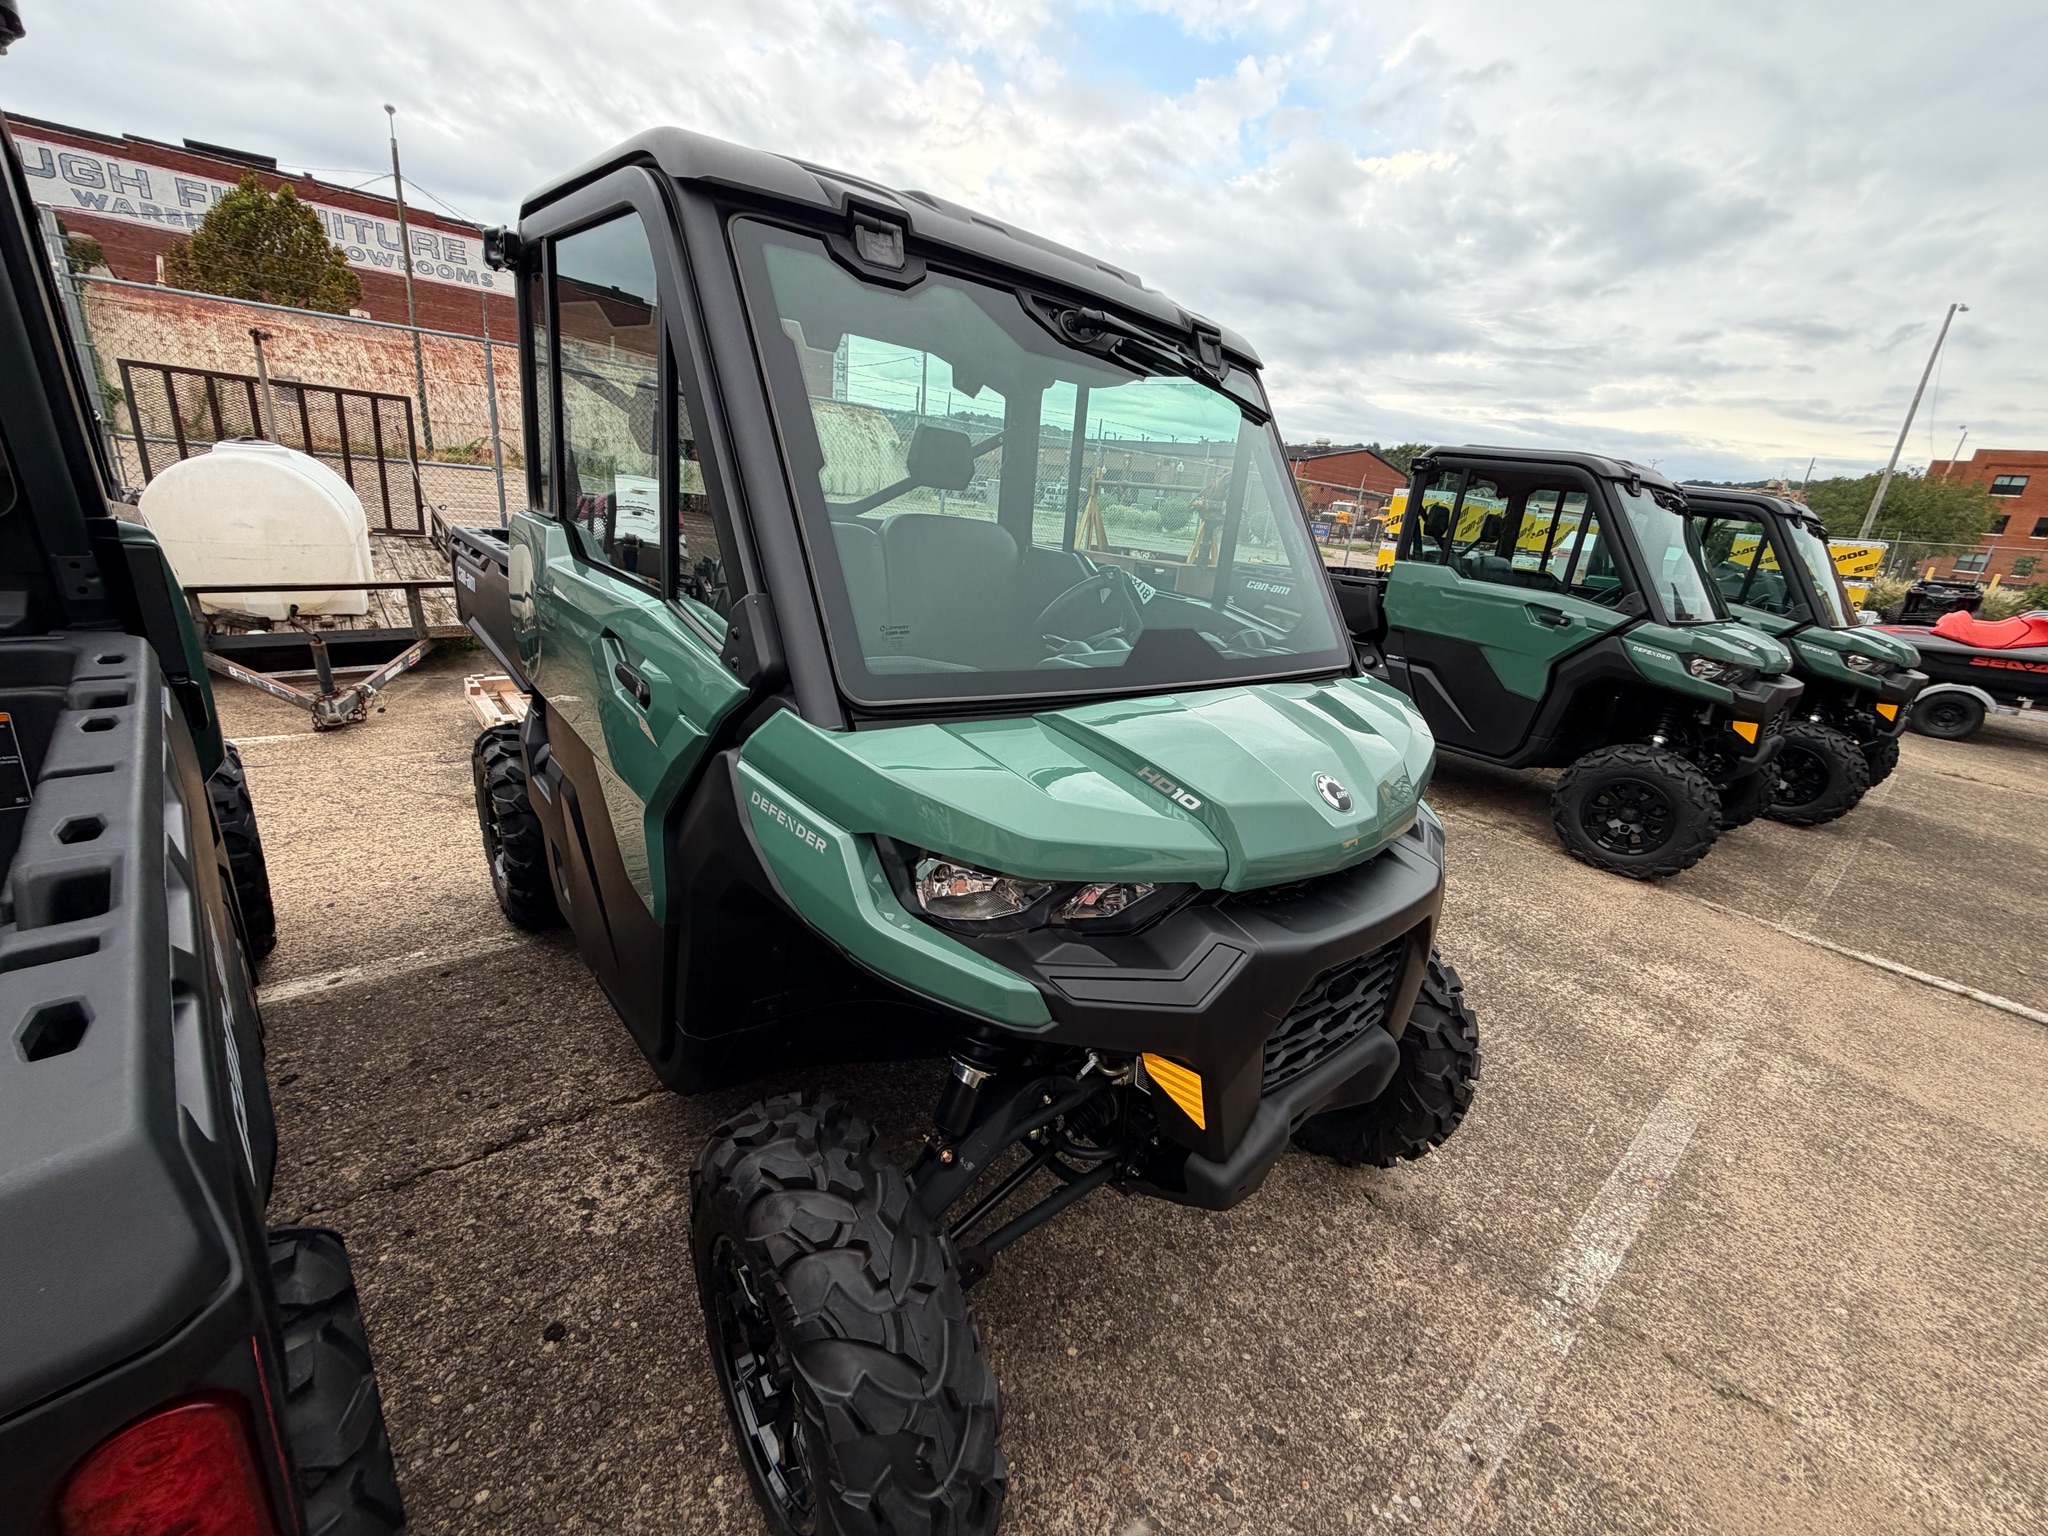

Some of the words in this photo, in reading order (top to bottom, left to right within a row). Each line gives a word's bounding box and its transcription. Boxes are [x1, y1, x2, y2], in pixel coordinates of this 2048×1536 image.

[1246, 579, 1291, 596] can-am
[1632, 645, 1672, 661] DEFENDER
[1800, 644, 1834, 657] DEFENDER
[1137, 766, 1203, 811] HD10
[751, 790, 828, 855] DEFENDER
